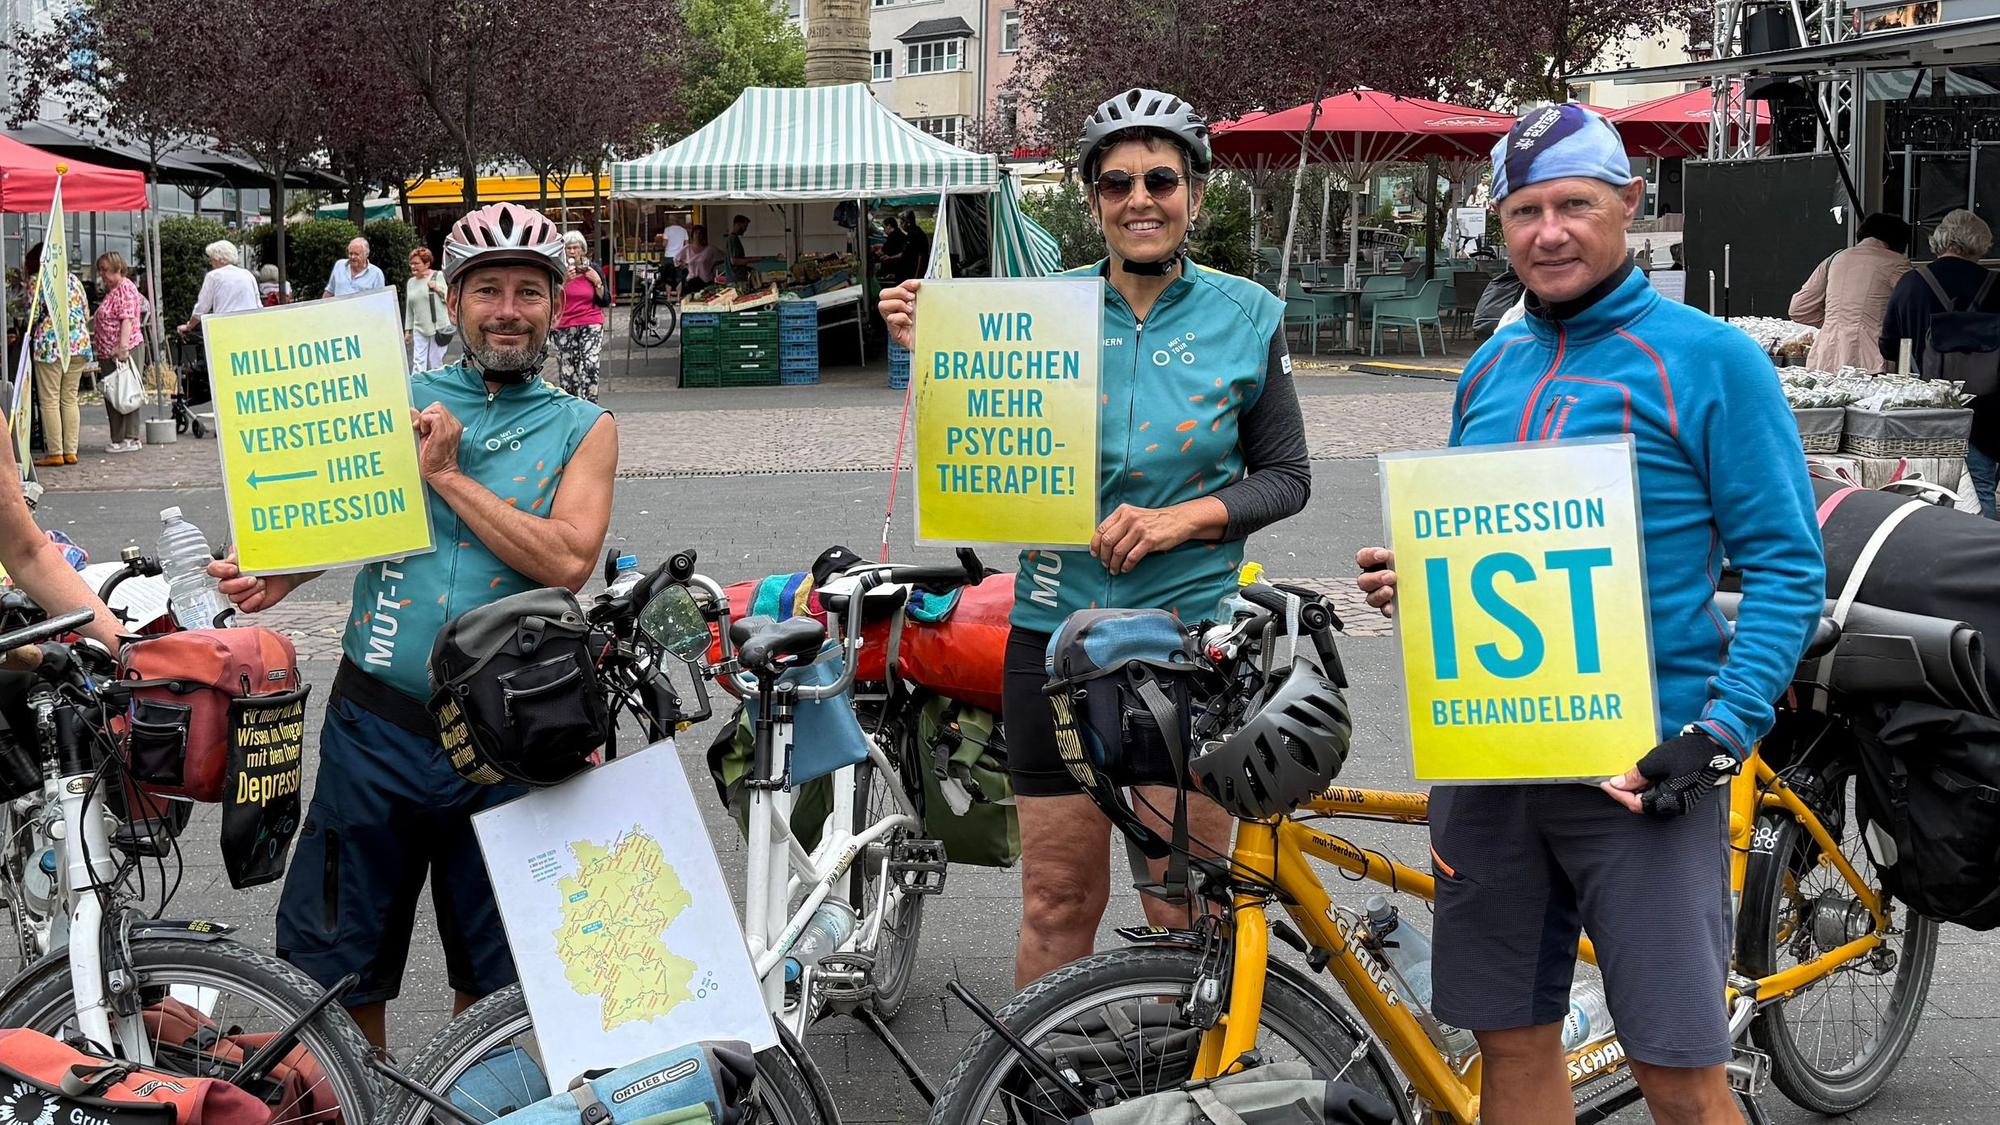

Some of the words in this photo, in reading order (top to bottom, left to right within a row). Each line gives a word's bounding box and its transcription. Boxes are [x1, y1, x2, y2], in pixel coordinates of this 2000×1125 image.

[979, 312, 1033, 341] WIR
[230, 335, 361, 376] MILLIONEN
[934, 351, 1080, 380] BRAUCHEN
[235, 373, 368, 415] MENSCHEN
[968, 389, 1043, 417] MEHR
[240, 409, 394, 453] VERSTECKEN
[947, 427, 1066, 456] PSYCHO-
[327, 451, 384, 483] IHRE
[936, 464, 1075, 495] THERAPIE!
[251, 488, 406, 531] DEPRESSION
[1414, 498, 1605, 539] DEPRESSION
[1425, 547, 1613, 680] IST
[1432, 693, 1623, 726] BEHANDELBAR
[237, 727, 271, 747] Wissen
[246, 748, 268, 768] mit
[616, 1075, 661, 1101] ORTLIEB
